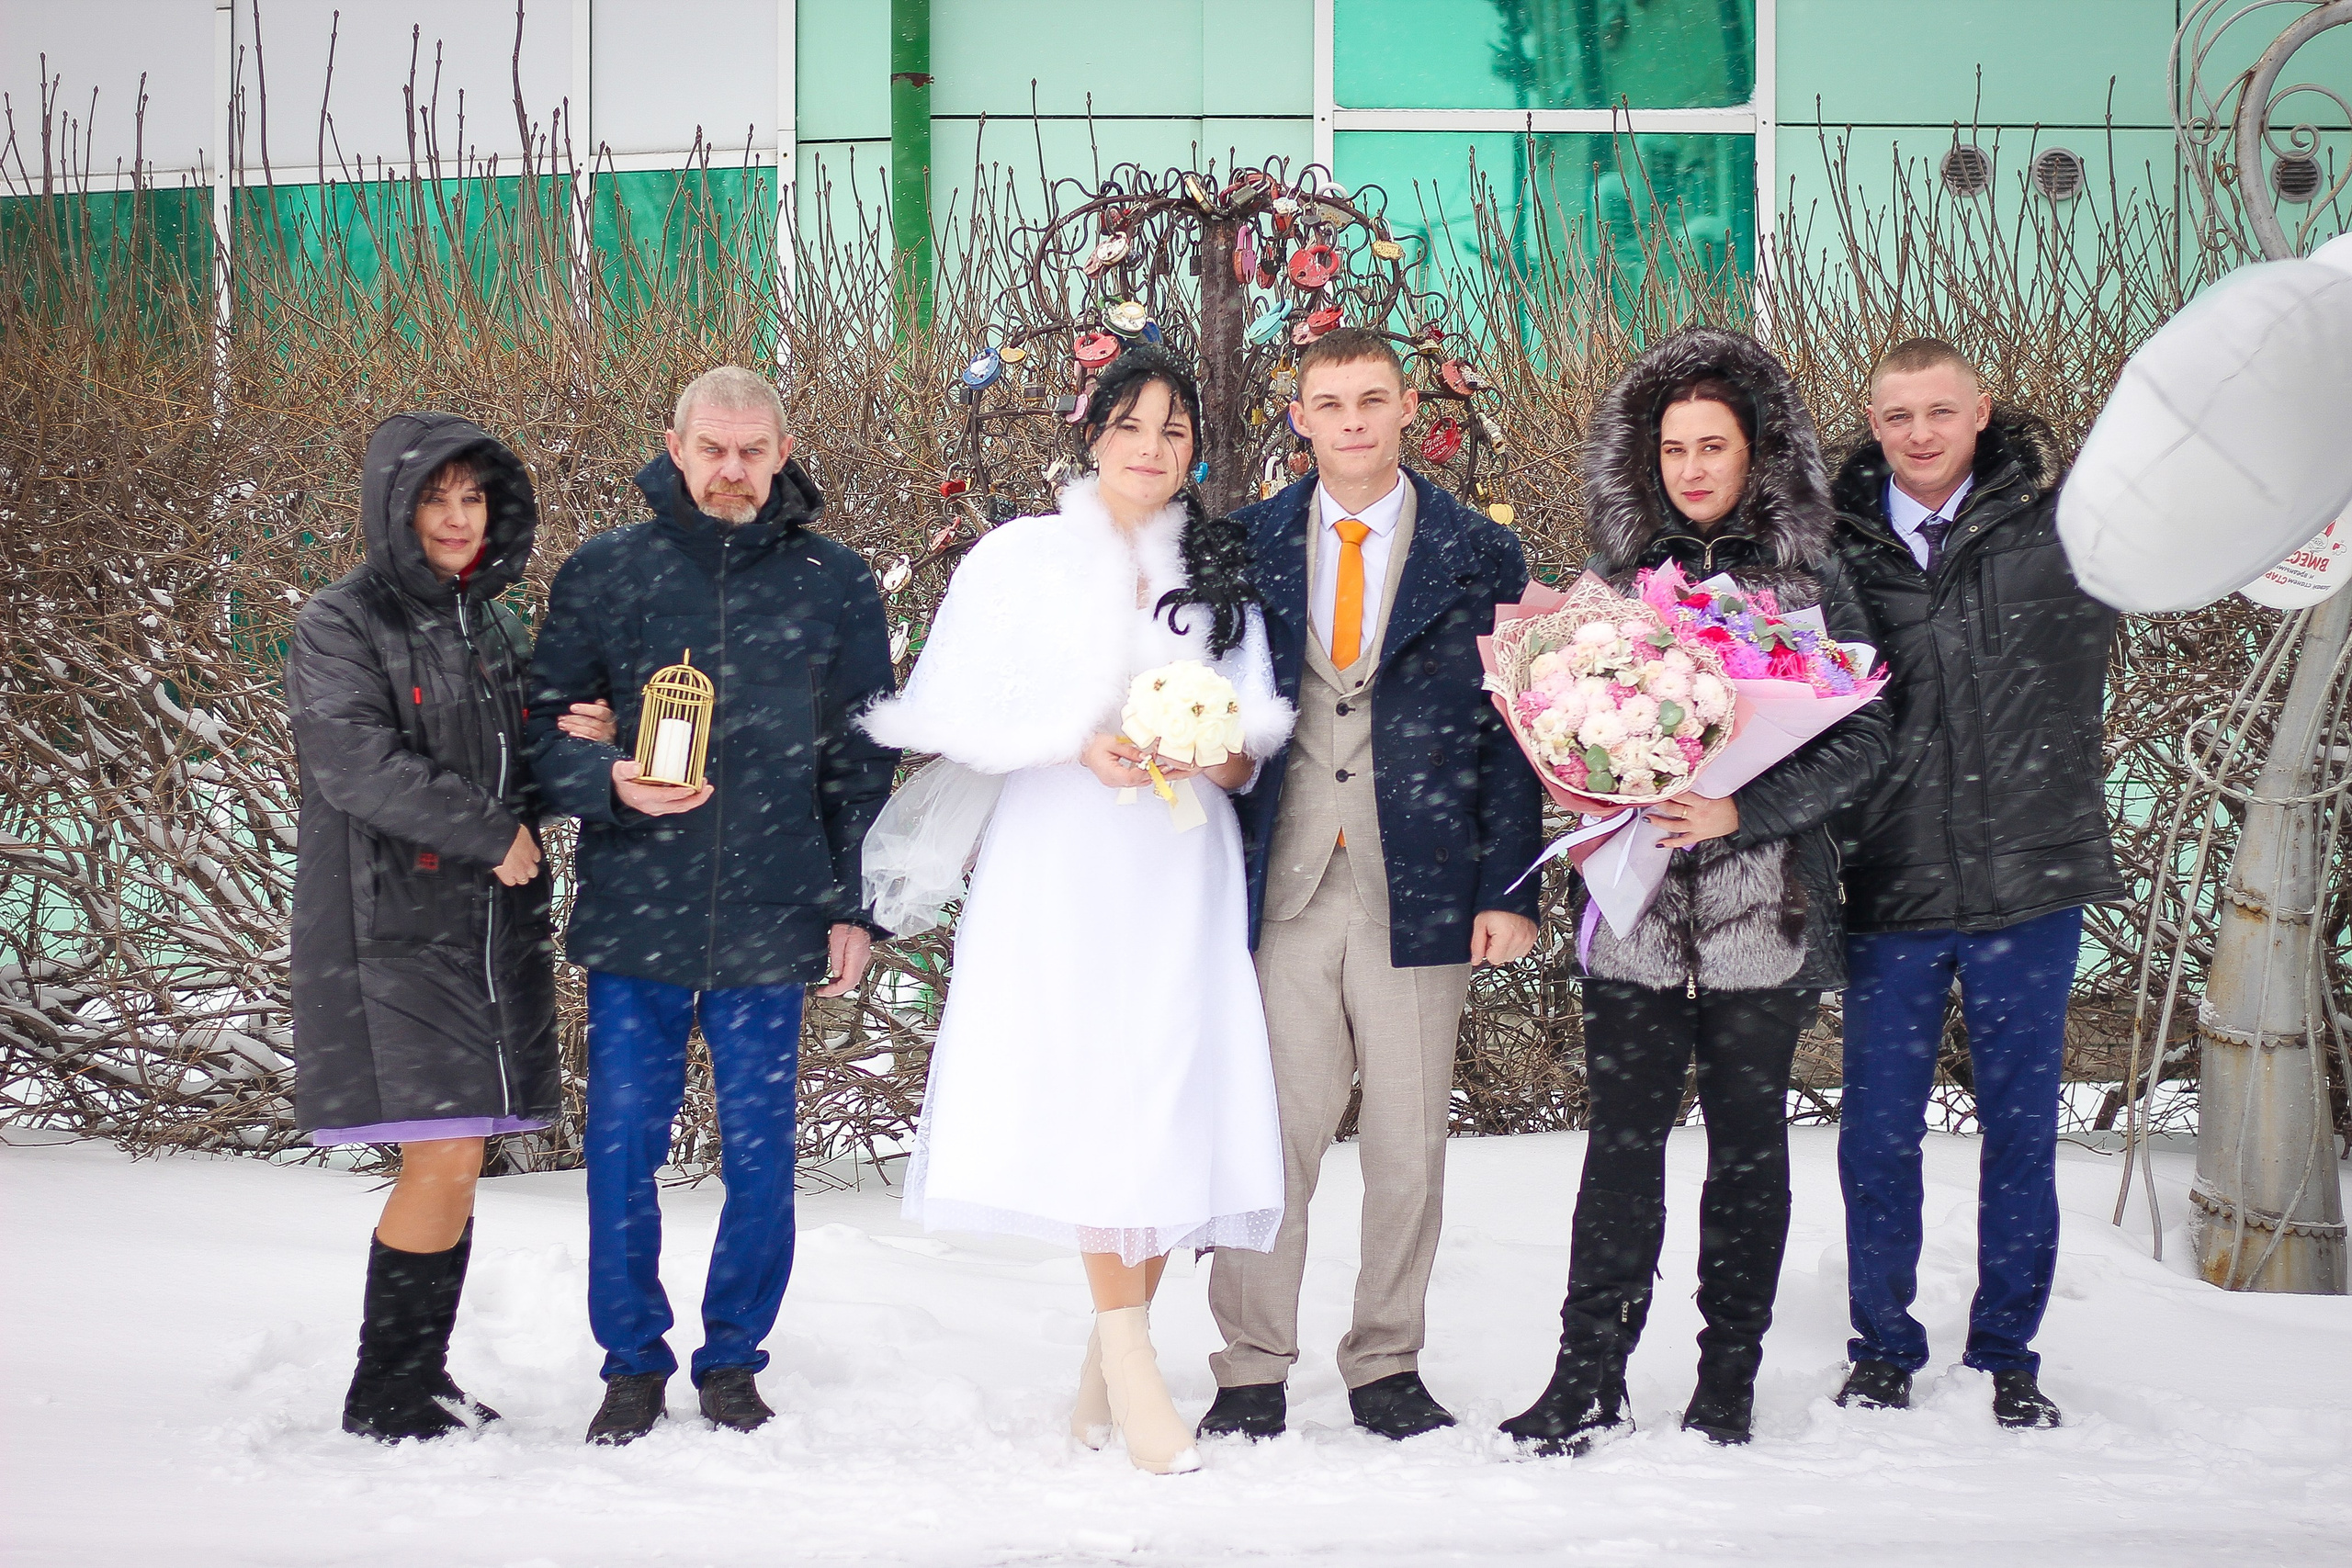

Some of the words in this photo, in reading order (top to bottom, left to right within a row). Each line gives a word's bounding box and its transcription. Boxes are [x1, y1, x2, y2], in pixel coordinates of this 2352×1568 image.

[2285, 550, 2330, 572] ВМЕС
[2264, 571, 2288, 585] СТАР
[2288, 578, 2312, 588] станем
